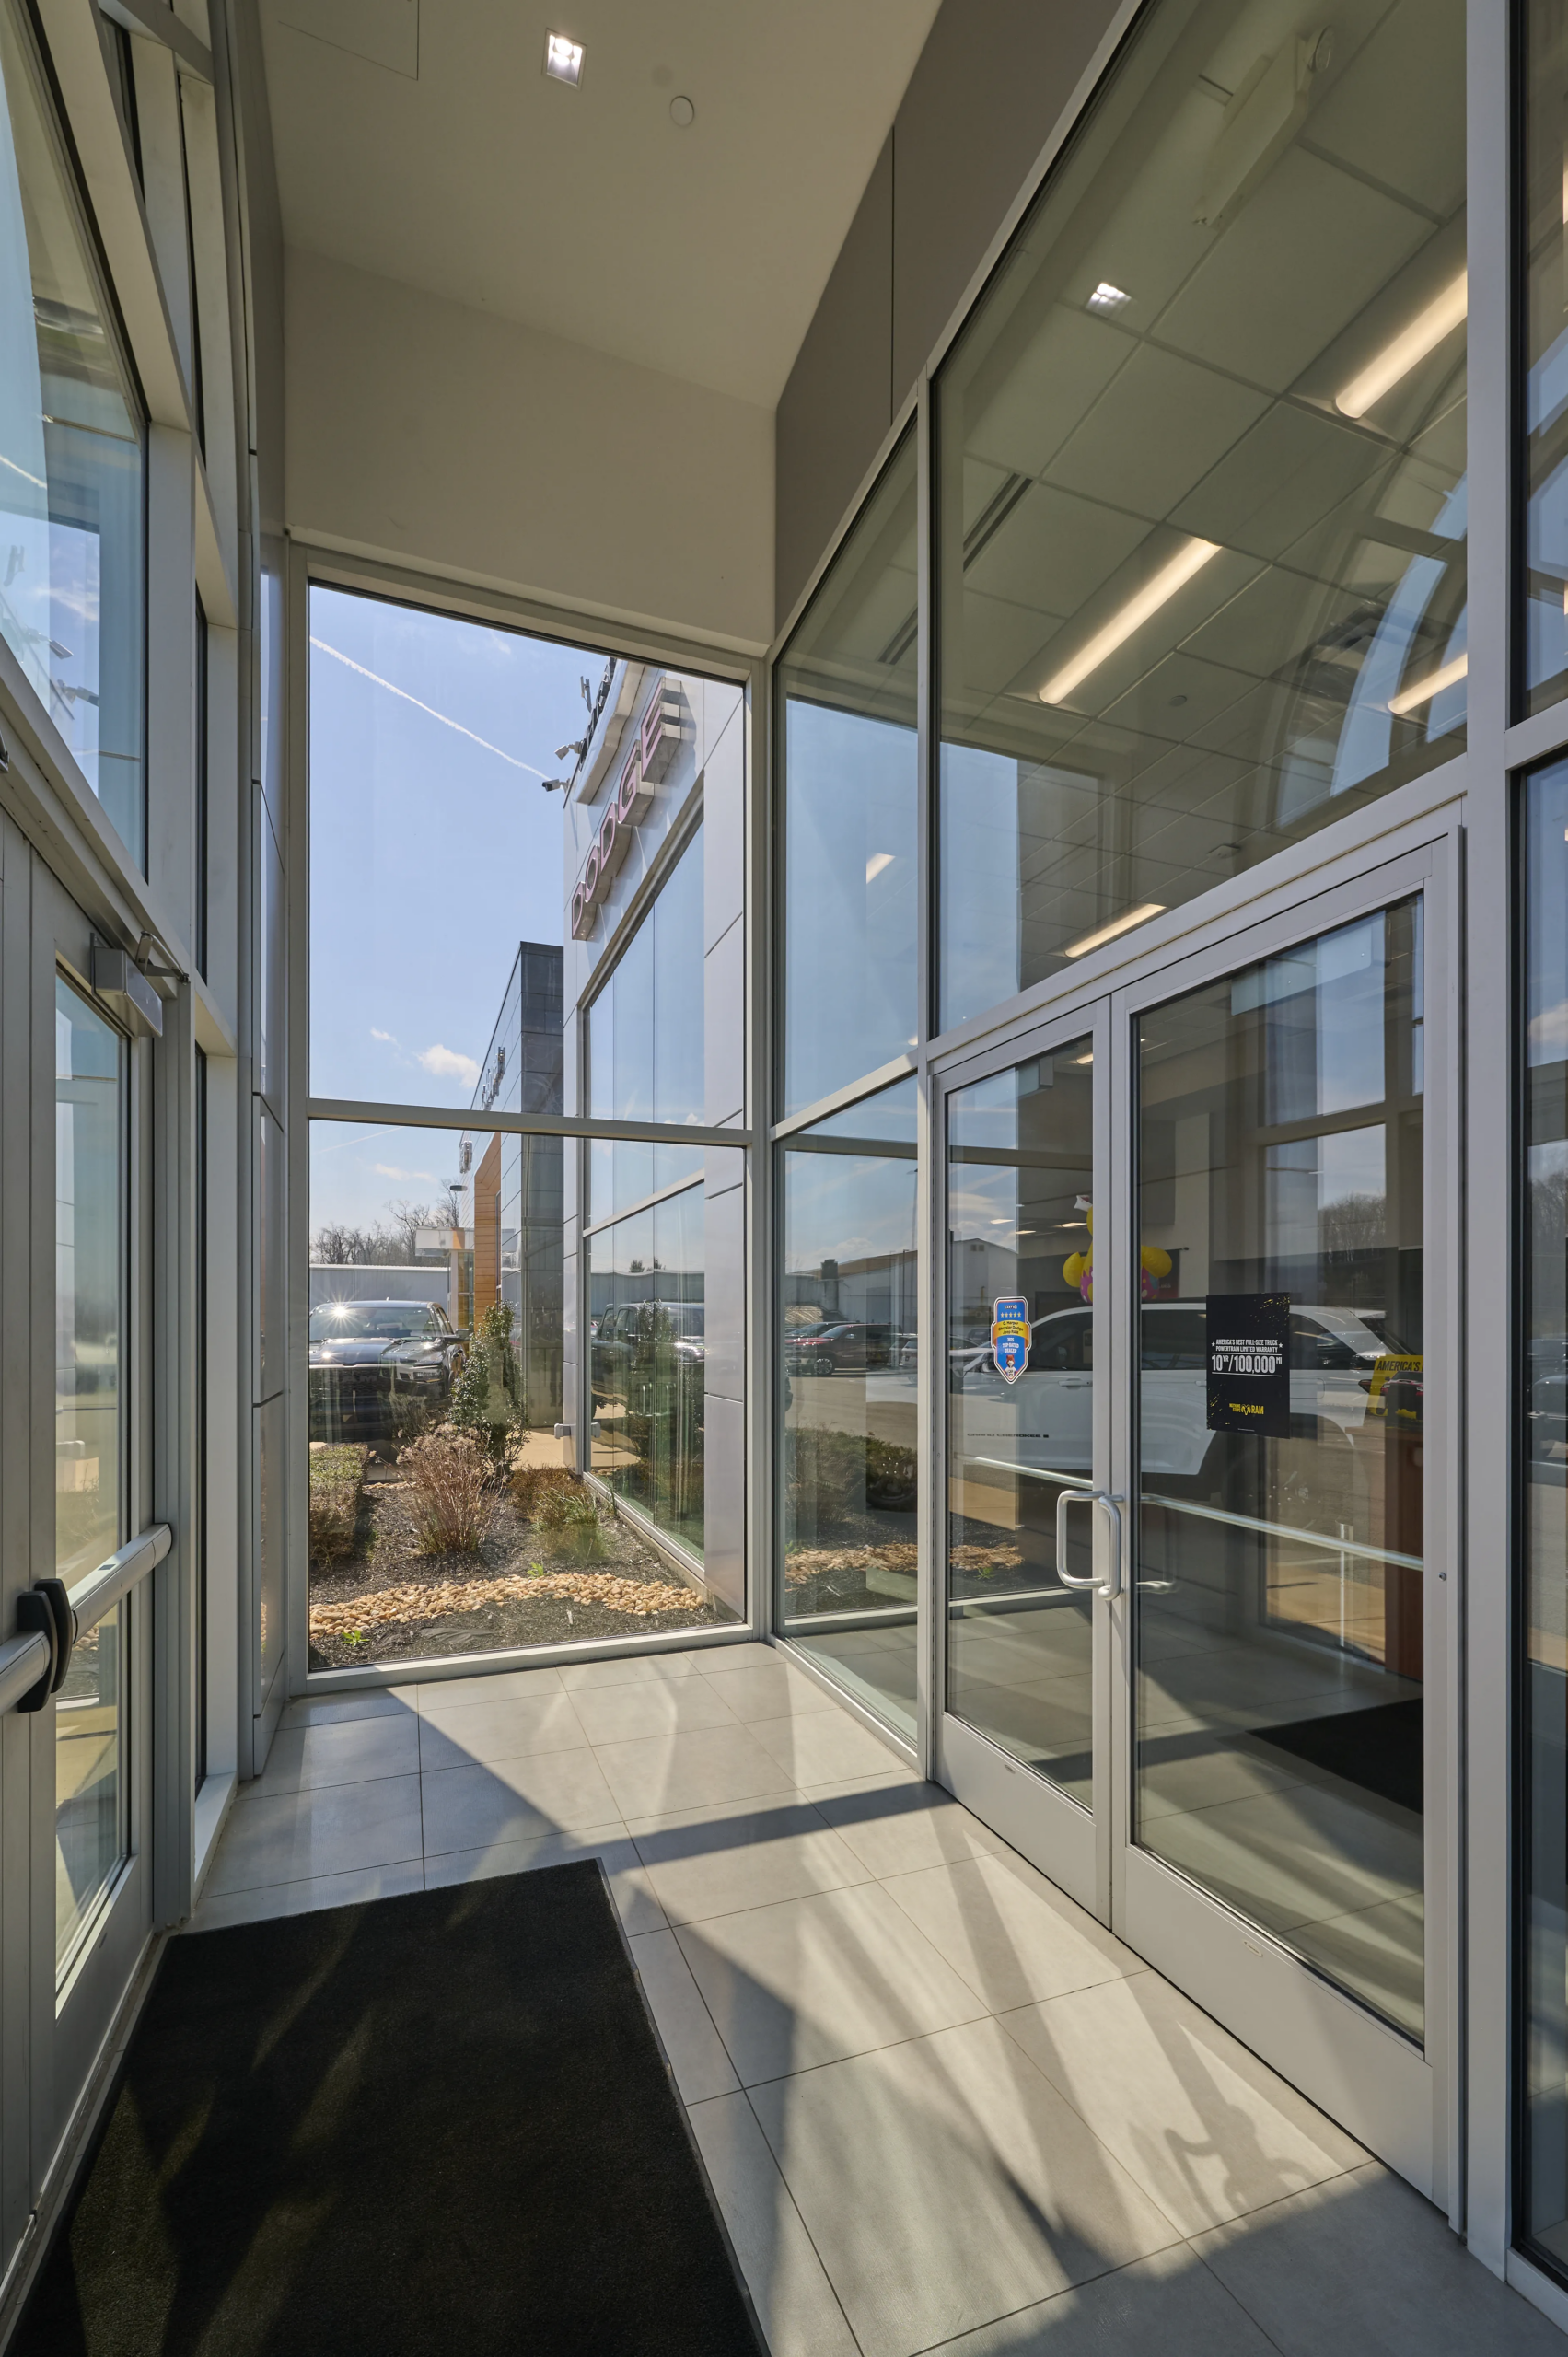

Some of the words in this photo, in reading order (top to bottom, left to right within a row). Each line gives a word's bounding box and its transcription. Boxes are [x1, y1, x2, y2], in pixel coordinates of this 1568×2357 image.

[572, 676, 679, 941] DODGE
[1376, 1360, 1421, 1372] AMERICA'S
[1251, 1405, 1264, 1415] RAM
